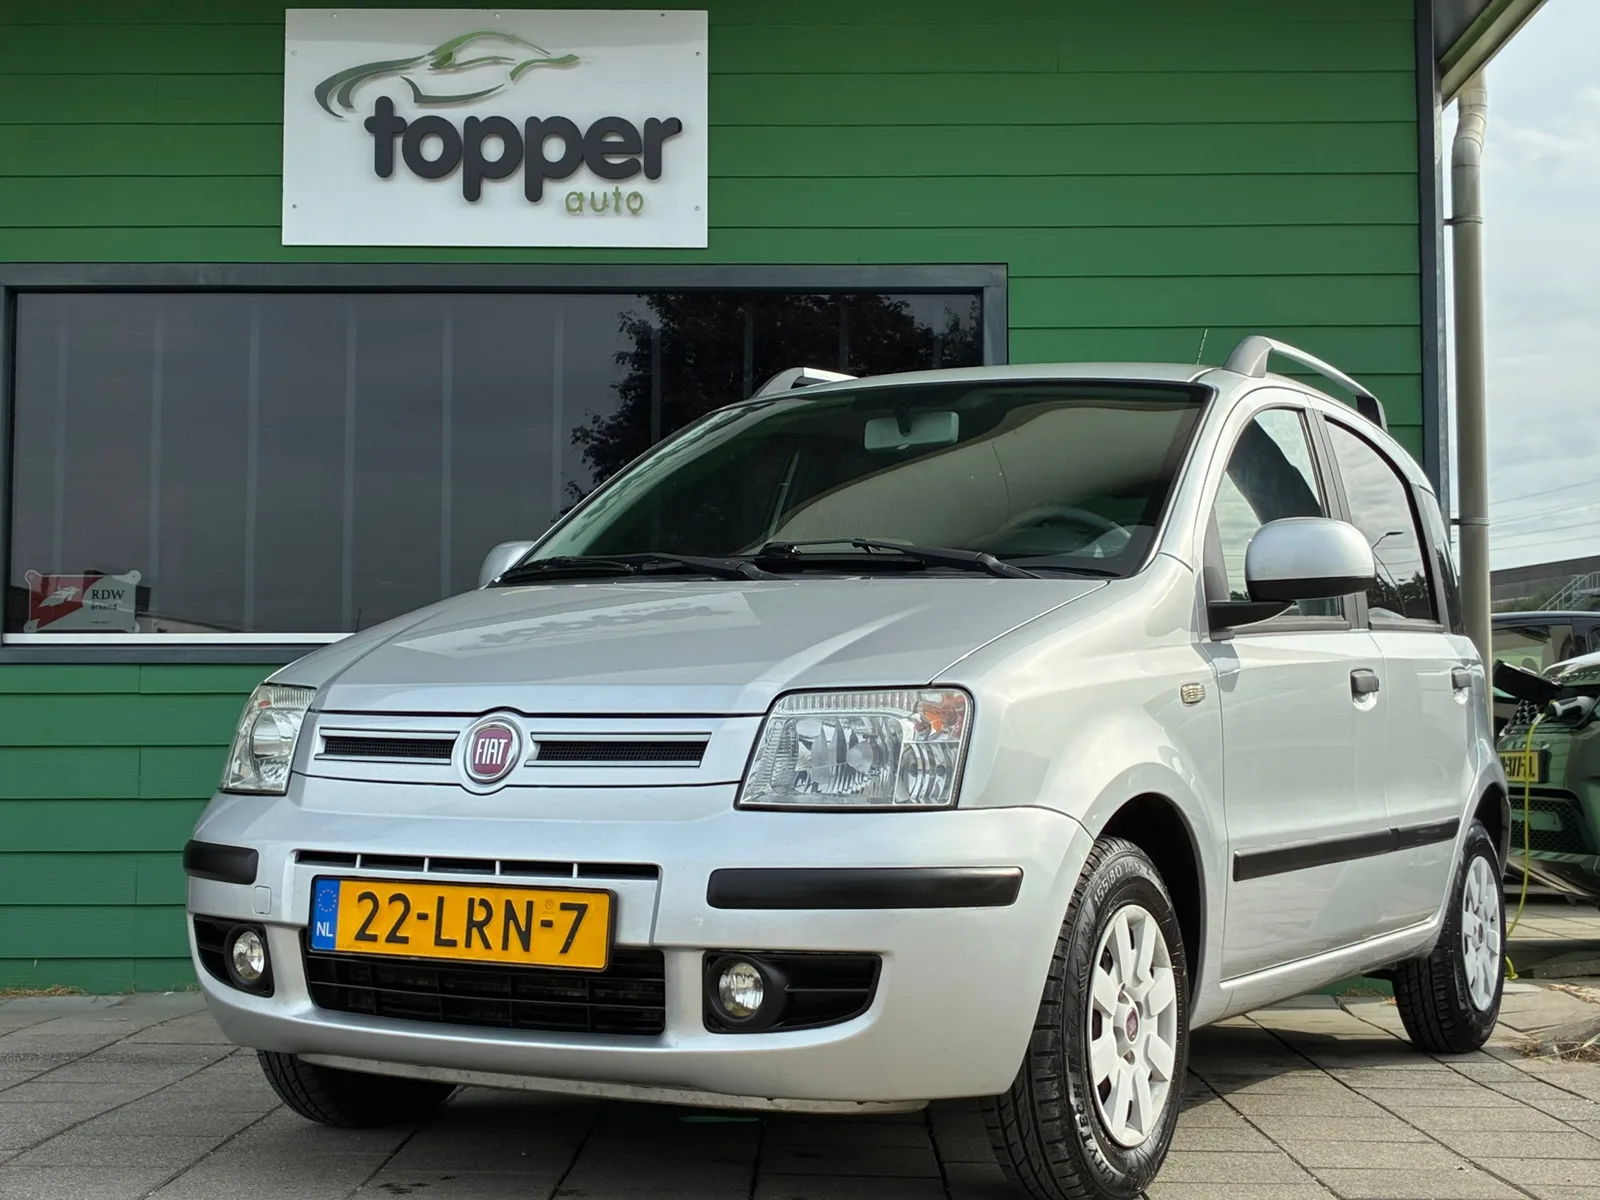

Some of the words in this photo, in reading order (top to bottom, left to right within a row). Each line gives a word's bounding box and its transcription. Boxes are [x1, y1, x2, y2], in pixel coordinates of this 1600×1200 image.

[364, 96, 682, 202] topper
[565, 186, 644, 214] auto
[91, 589, 125, 600] RDW
[475, 738, 508, 765] FIAT
[316, 921, 334, 938] NL
[354, 891, 589, 954] 22-LRN-7
